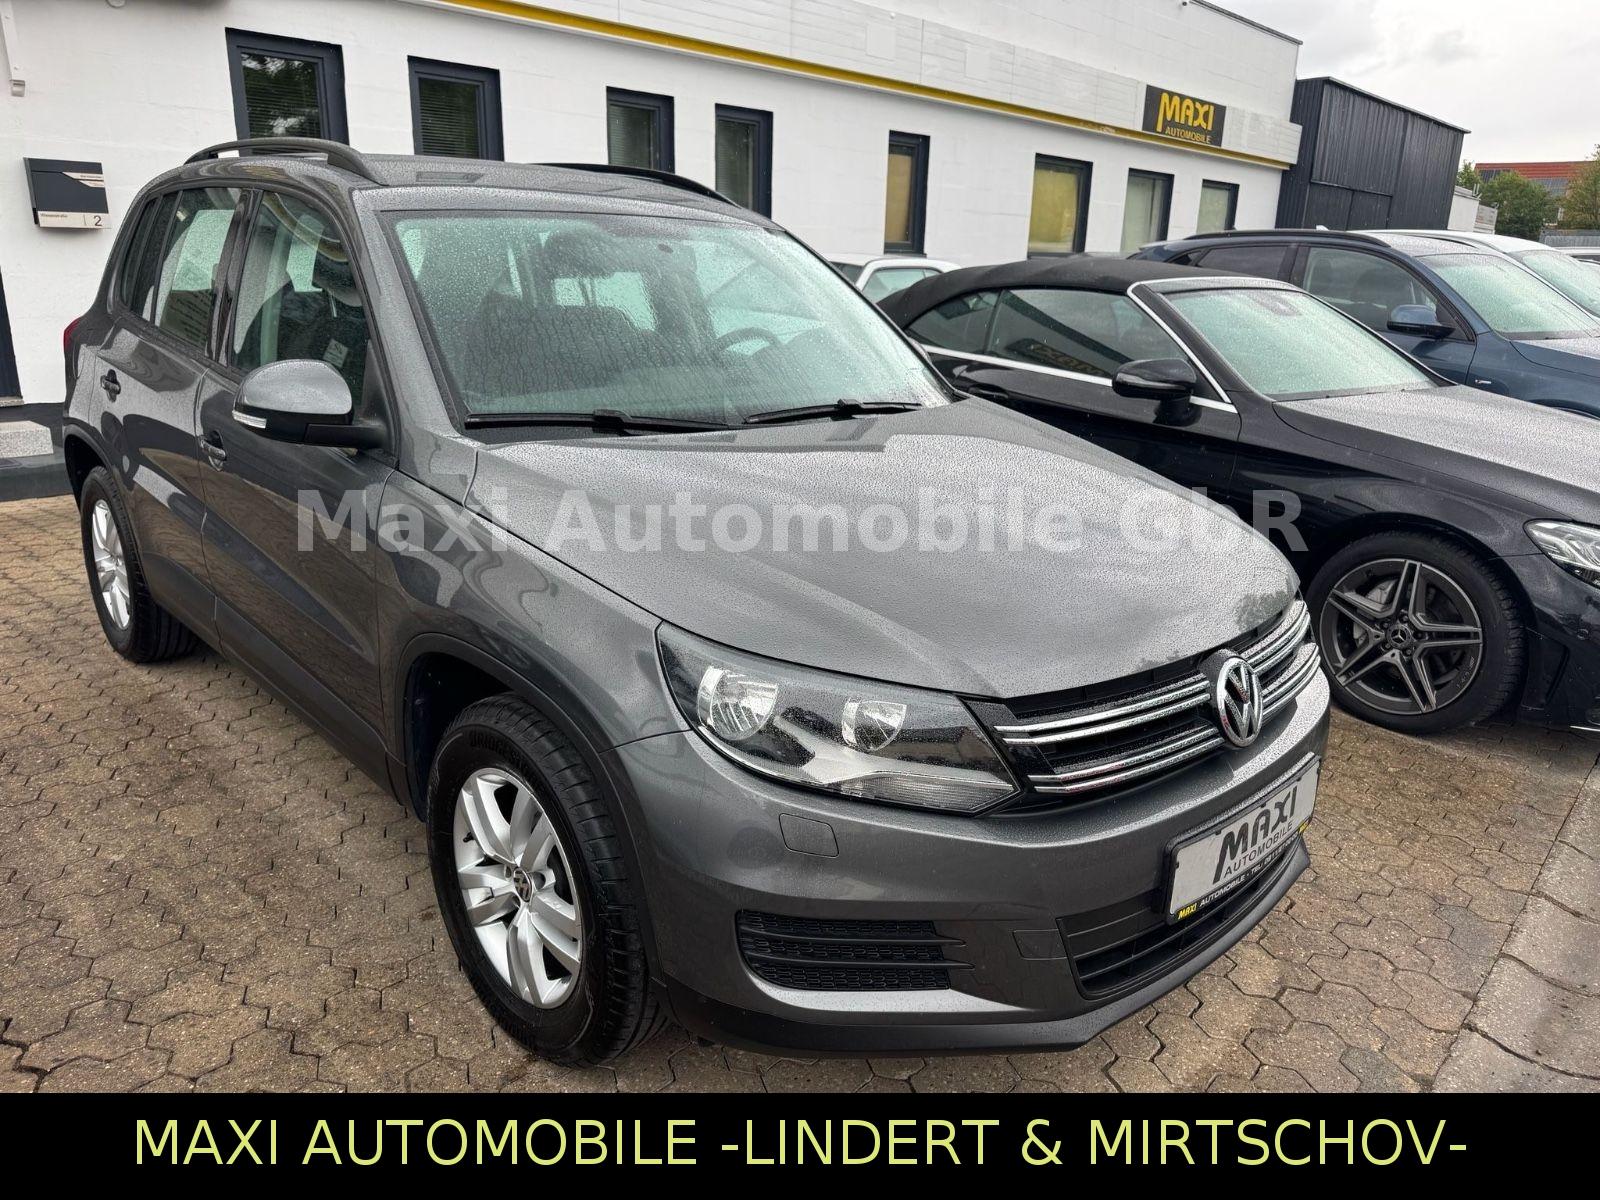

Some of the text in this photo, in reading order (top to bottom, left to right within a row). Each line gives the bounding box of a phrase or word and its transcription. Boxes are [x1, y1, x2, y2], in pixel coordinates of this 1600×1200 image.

[1156, 92, 1215, 133] MAXI
[1165, 126, 1212, 144] AUTOMOBILE
[93, 215, 103, 227] 2
[1212, 785, 1298, 885] MAXI
[1223, 821, 1293, 879] AUTOMOBILE
[1177, 873, 1246, 920] MAXI AUTOMOBILE
